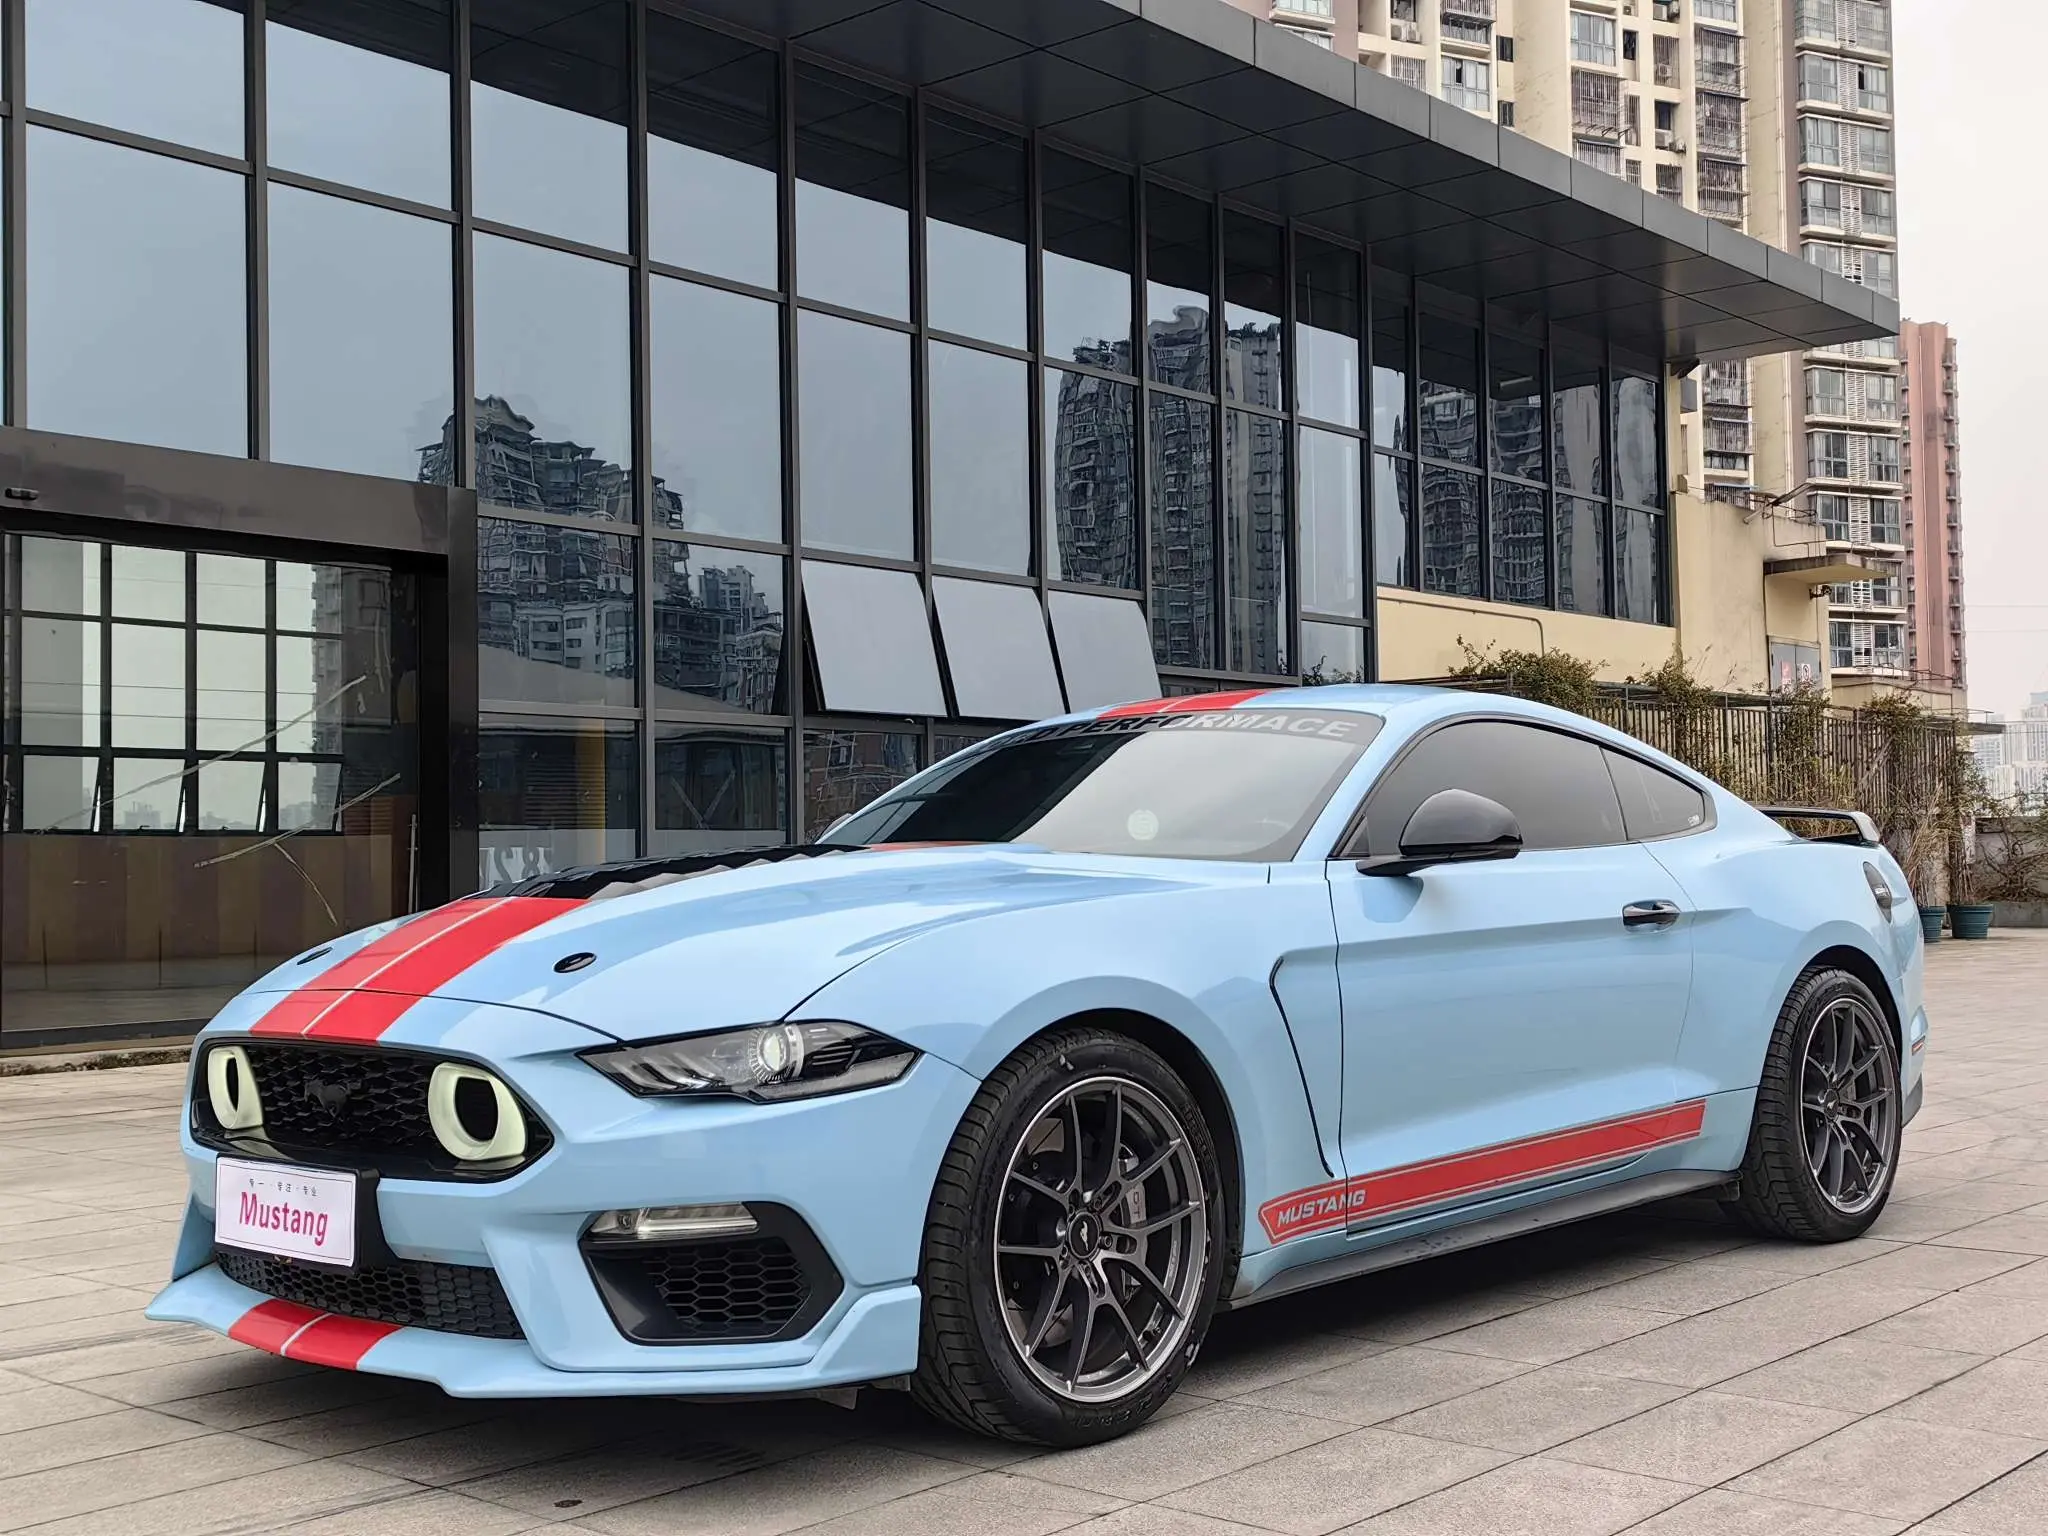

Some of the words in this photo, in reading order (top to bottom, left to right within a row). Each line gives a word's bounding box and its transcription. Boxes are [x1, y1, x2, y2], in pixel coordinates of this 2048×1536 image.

[1055, 713, 1357, 738] PERFORMACE
[239, 1191, 328, 1247] Mustang
[1277, 1189, 1366, 1228] MUSTANG
